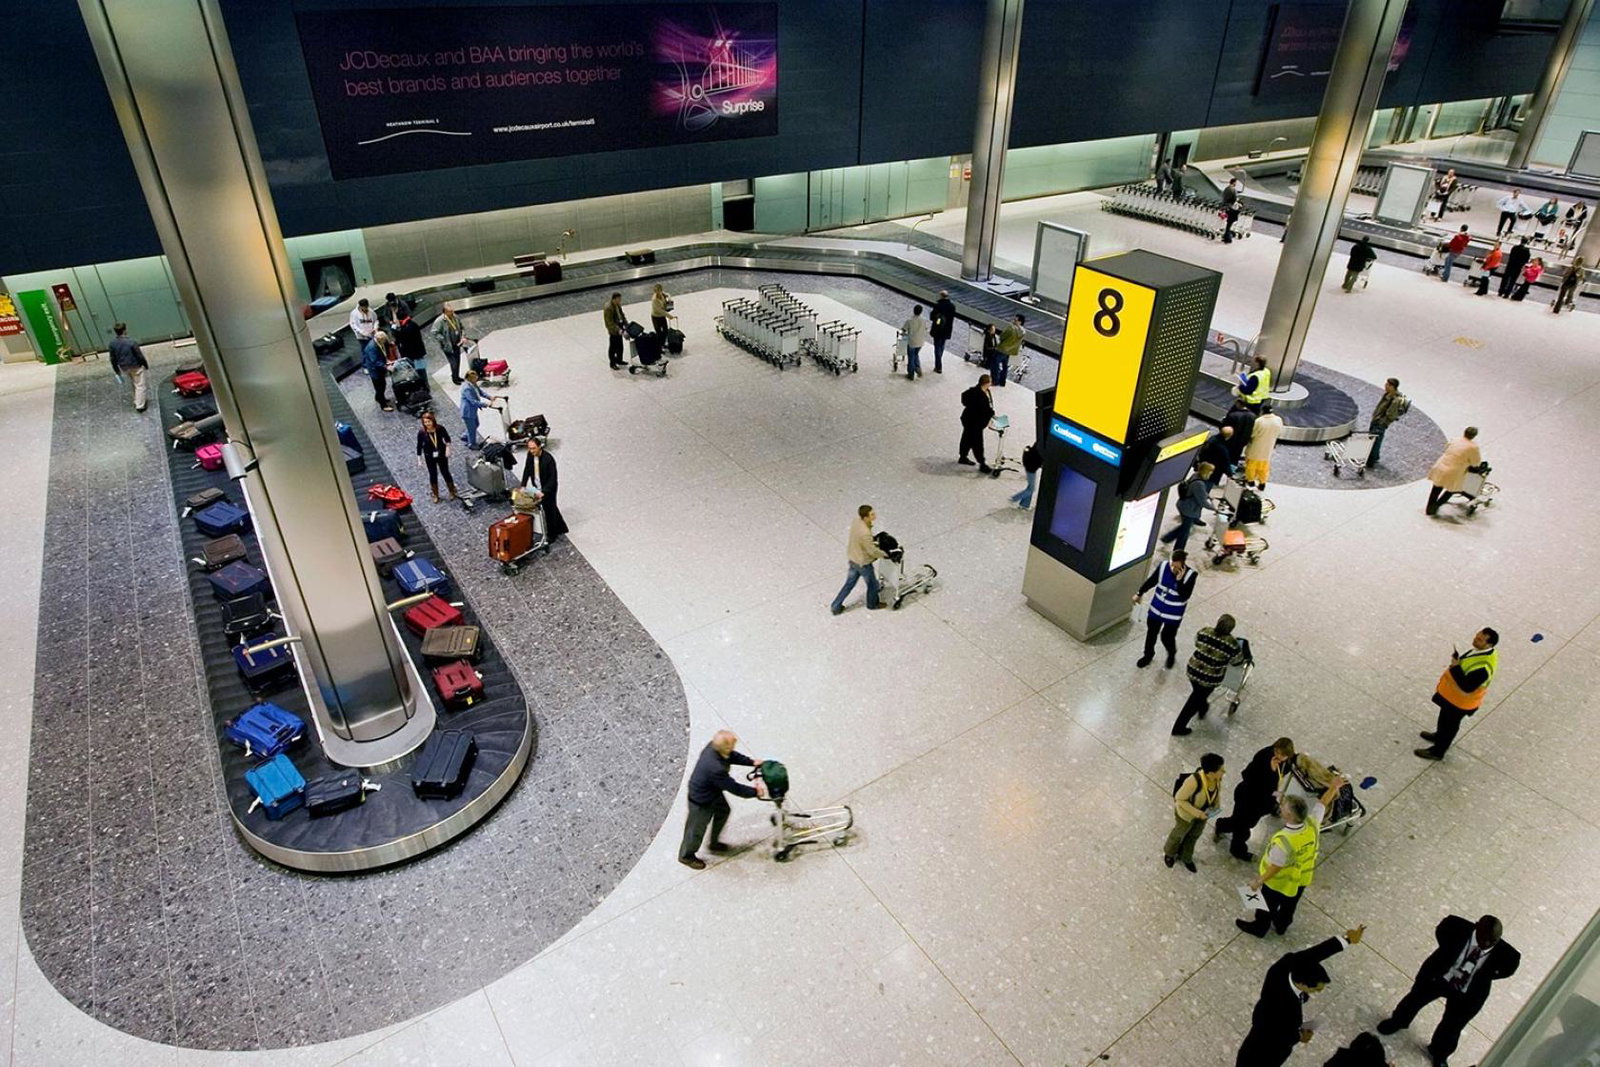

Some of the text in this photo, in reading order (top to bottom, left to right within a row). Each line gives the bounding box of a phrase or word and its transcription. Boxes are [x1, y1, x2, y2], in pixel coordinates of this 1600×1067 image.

[340, 41, 645, 71] JCDecaux and BAA bringing the world's
[344, 65, 621, 96] best brands and audiences together
[722, 99, 764, 115] Surprise
[1093, 287, 1125, 338] 8
[1054, 423, 1083, 444] Customs
